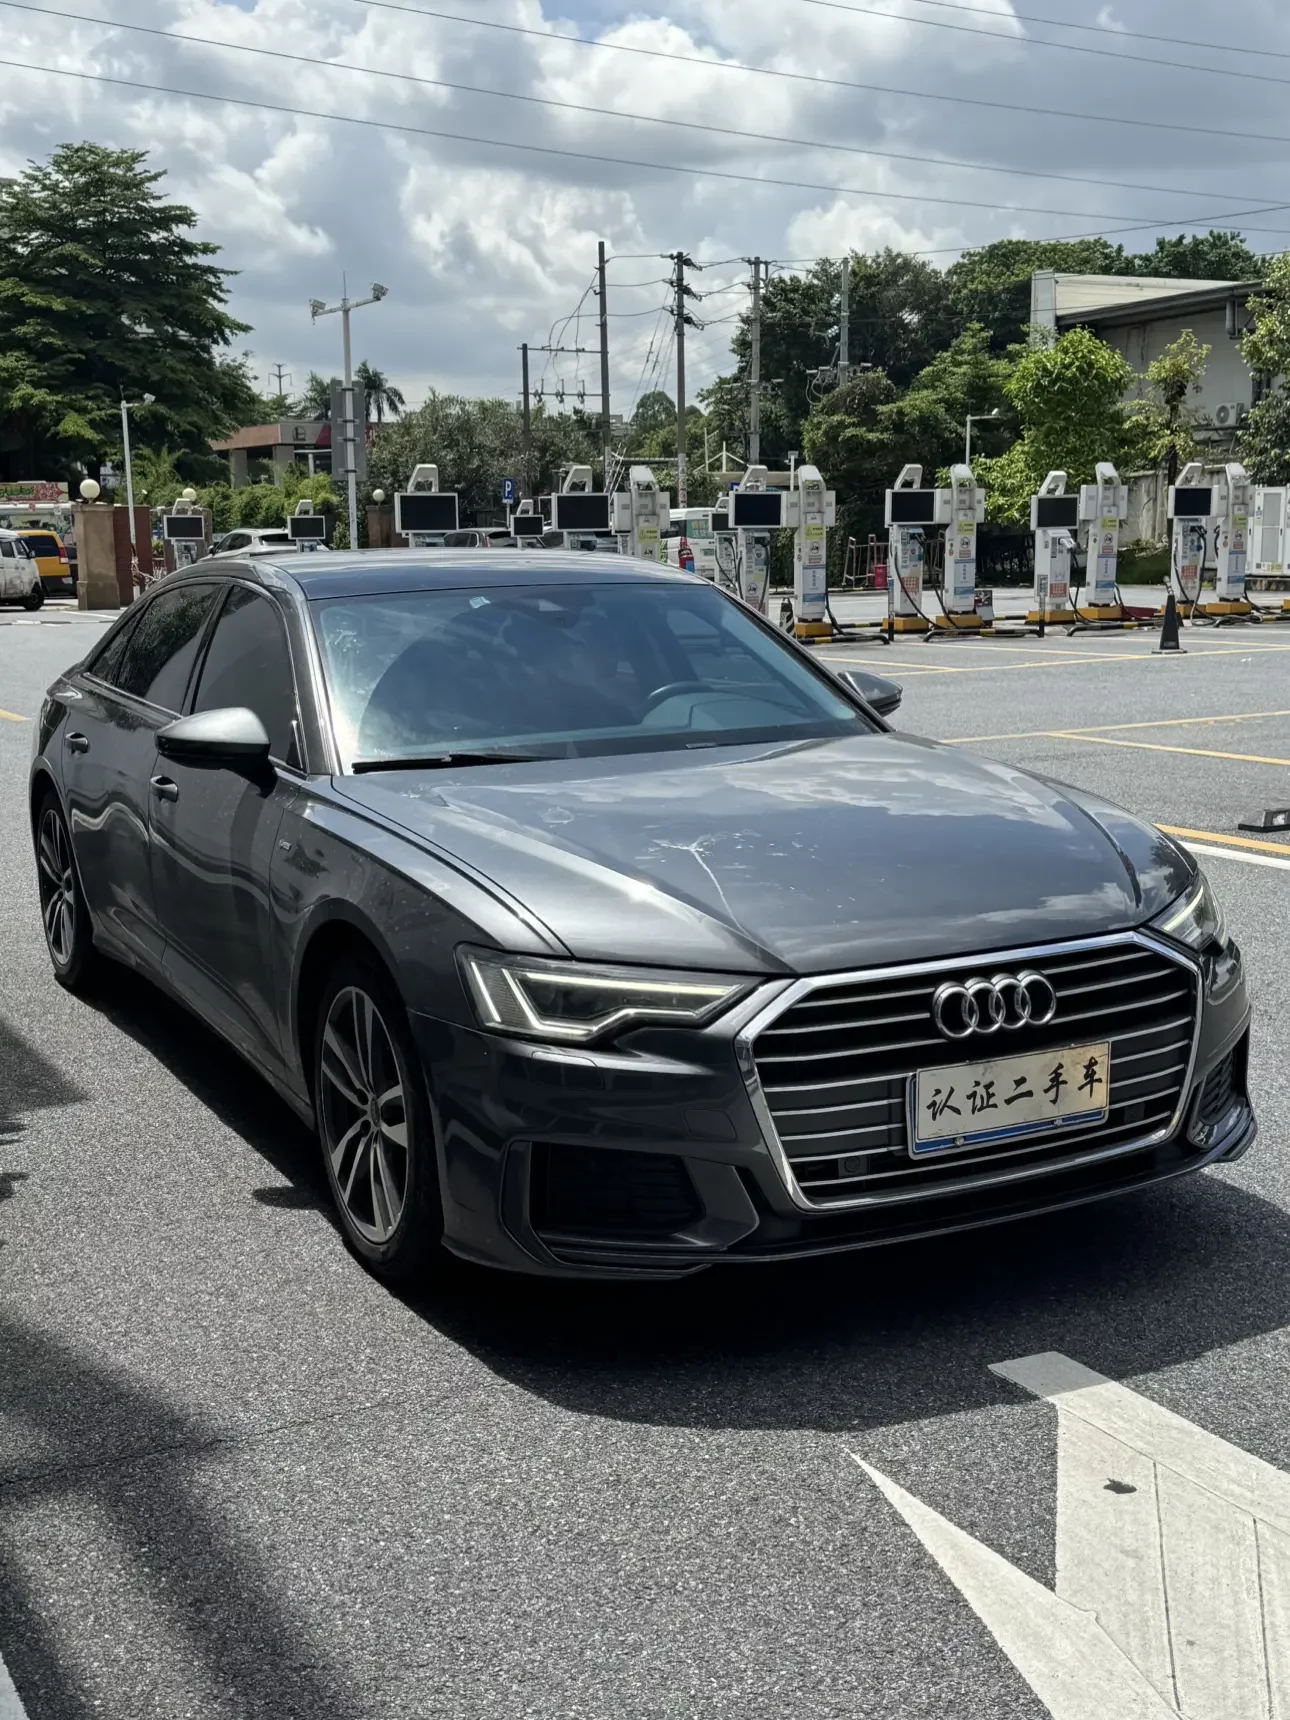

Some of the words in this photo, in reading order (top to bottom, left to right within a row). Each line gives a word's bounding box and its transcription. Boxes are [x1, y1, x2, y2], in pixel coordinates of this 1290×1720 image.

[505, 480, 512, 497] P
[926, 1056, 1103, 1121] 认证二手车
